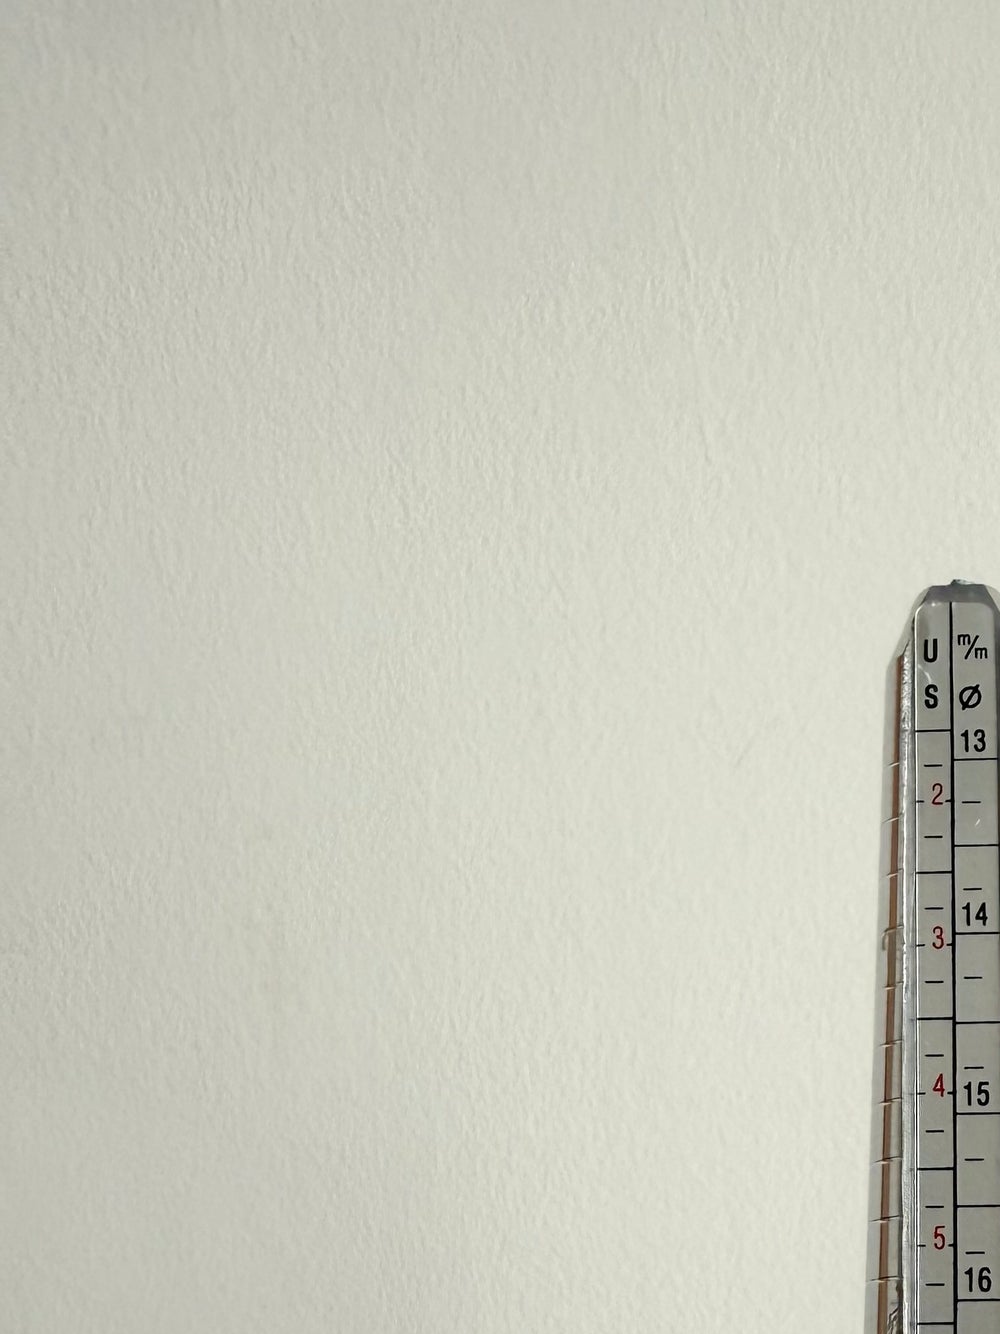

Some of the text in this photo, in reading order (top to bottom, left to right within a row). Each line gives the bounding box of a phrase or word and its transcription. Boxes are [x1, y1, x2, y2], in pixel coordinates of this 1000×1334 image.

[960, 729, 987, 753] 13
[931, 783, 944, 805] 2
[961, 902, 988, 926] 14
[932, 926, 944, 949] 3
[932, 1073, 945, 1097] 4
[963, 1081, 990, 1106] 15
[933, 1225, 946, 1250] 5
[964, 1266, 992, 1293] 16
